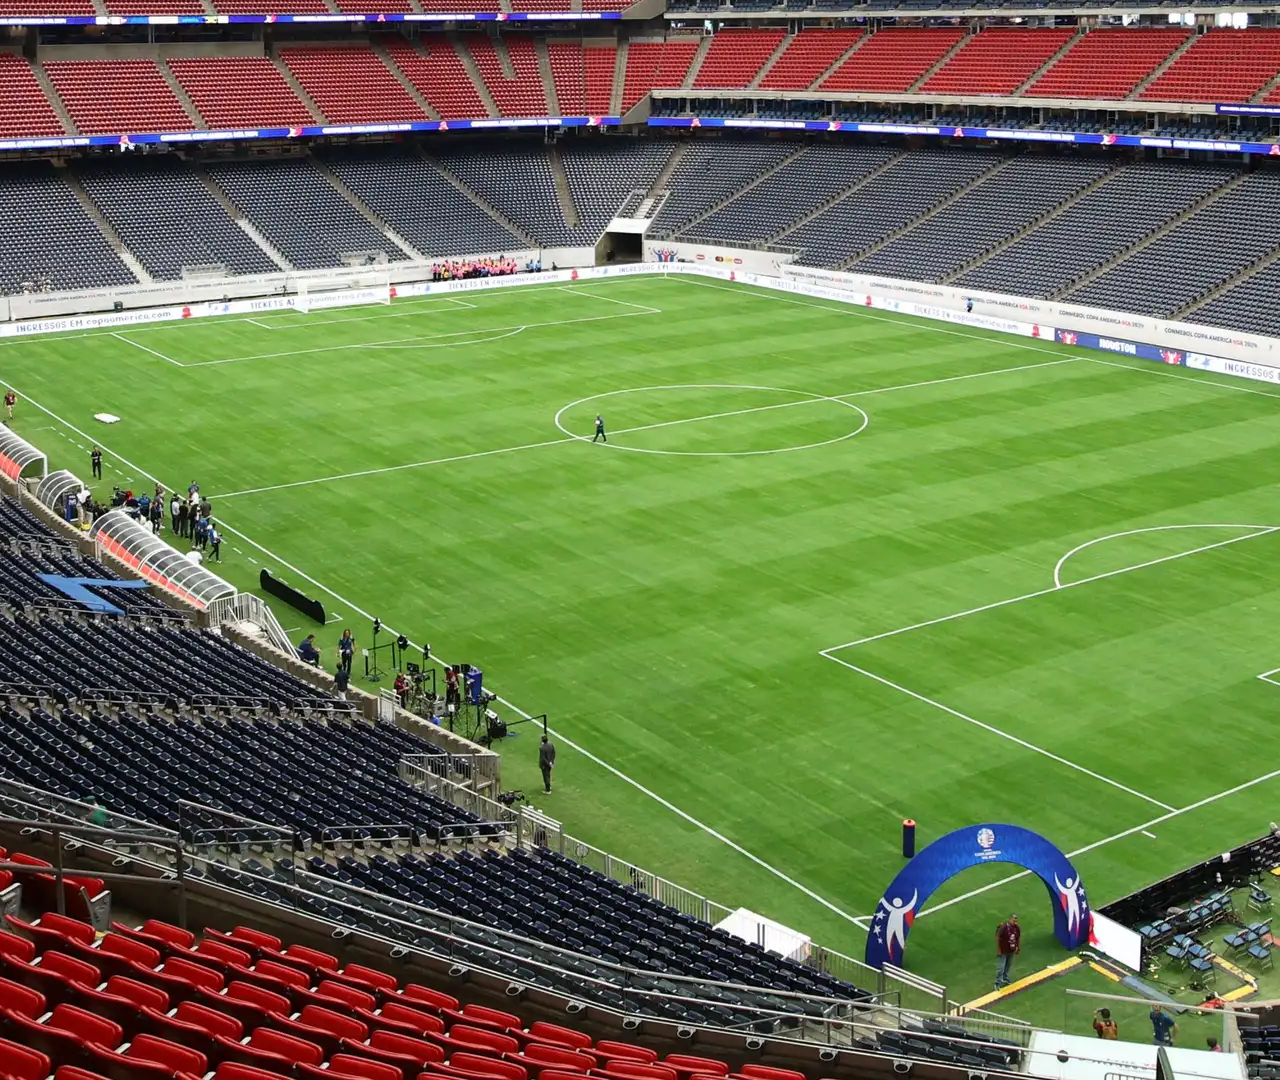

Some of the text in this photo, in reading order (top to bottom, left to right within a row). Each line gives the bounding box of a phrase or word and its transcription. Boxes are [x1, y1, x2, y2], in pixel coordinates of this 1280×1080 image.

[16, 322, 67, 333] INGRESSOS
[70, 318, 83, 328] EM
[1098, 338, 1136, 355] HOUSTON
[1224, 362, 1274, 379] INGRESSOS
